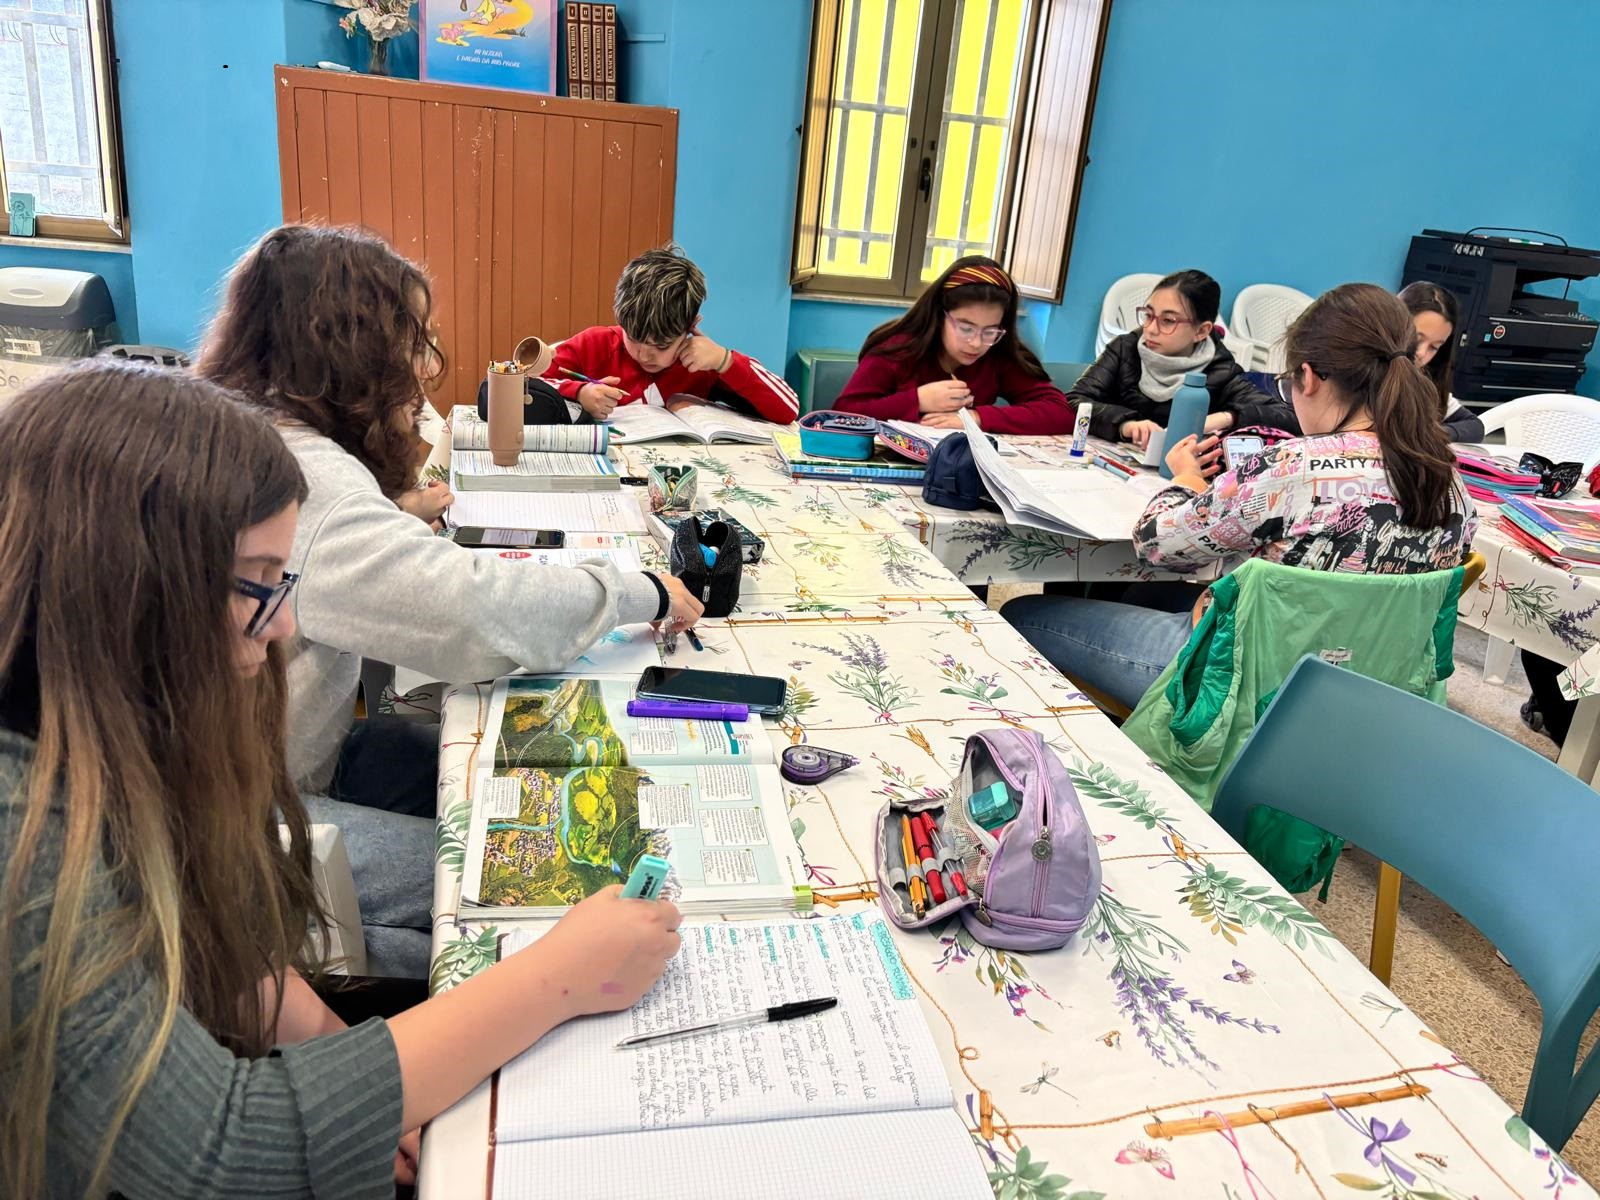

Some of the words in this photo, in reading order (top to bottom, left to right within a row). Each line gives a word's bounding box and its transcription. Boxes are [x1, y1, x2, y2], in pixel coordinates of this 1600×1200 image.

[571, 68, 576, 76] LA
[596, 70, 601, 78] LA
[608, 70, 613, 79] LA
[1310, 458, 1367, 471] PARTY
